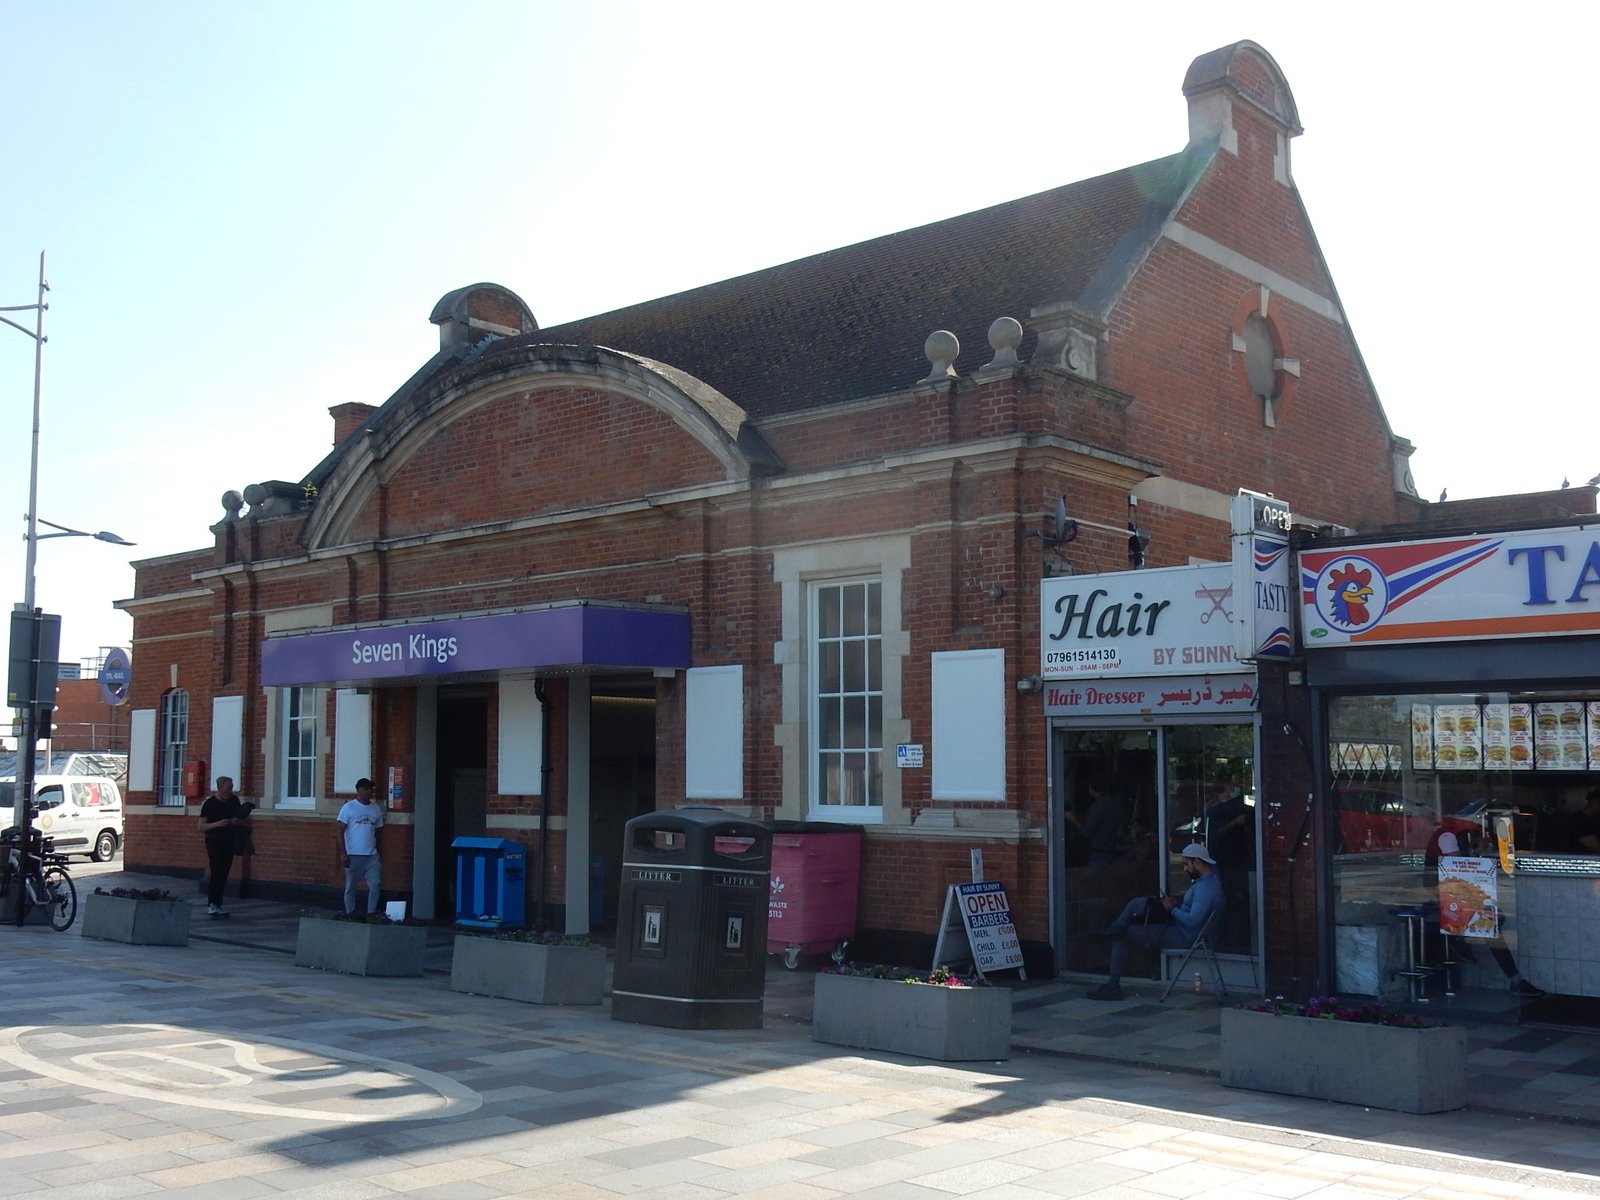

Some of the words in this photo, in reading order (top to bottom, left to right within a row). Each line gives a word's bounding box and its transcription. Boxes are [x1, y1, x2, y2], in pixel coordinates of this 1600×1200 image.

[1255, 581, 1289, 613] TASTY
[1049, 589, 1171, 641] Hair
[352, 640, 403, 664] Seven
[409, 633, 458, 663] Kings
[1047, 649, 1117, 663] 07961514130
[1153, 647, 1176, 665] BY
[1182, 645, 1234, 664] SUNN
[1048, 688, 1082, 706] Hair
[1086, 687, 1145, 705] Dresser
[638, 871, 672, 881] LITTER
[723, 877, 754, 886] LITTER
[967, 893, 1006, 914] OPEN
[971, 912, 1010, 928] BARBERS
